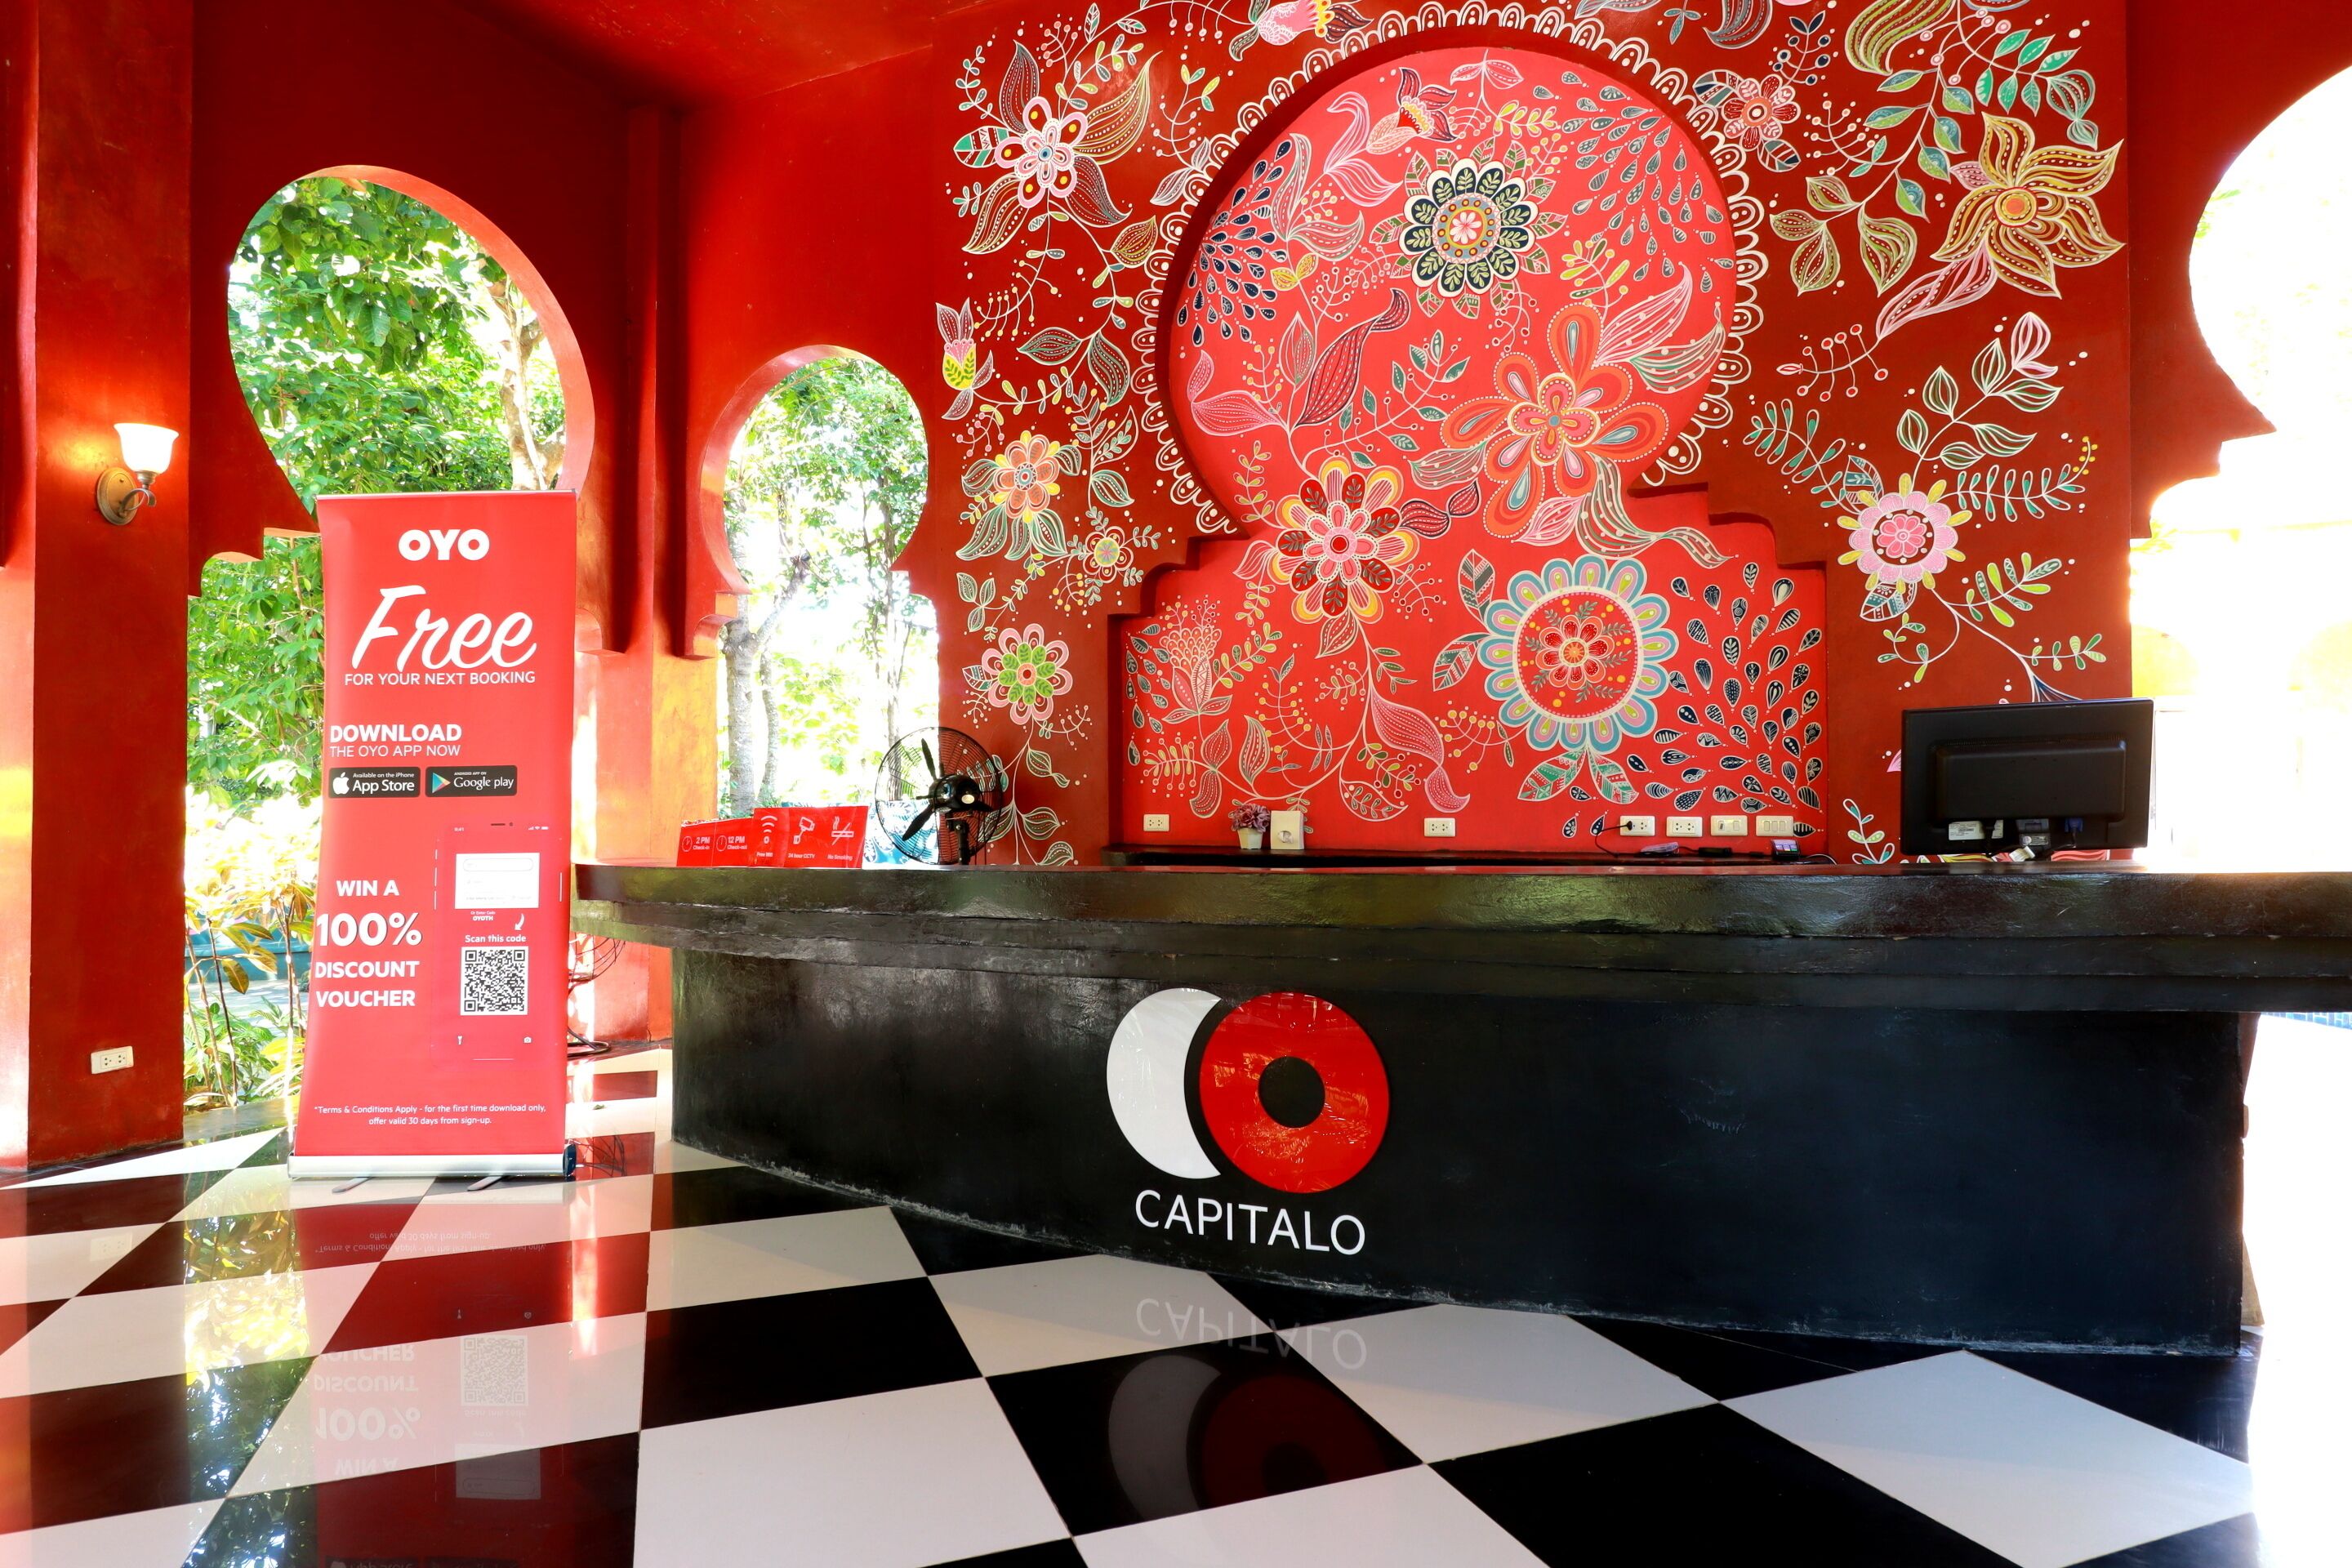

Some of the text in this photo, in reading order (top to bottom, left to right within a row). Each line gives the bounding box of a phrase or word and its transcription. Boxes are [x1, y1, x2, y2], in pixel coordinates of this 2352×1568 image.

[399, 528, 490, 561] OYO
[351, 585, 537, 672] Free
[345, 670, 536, 686] FOR YOUR NEXT BOOKING
[329, 724, 462, 743] DOWNLOAD
[330, 744, 461, 757] THE OYO APP NOW
[352, 779, 415, 795] App Store
[453, 777, 514, 791] Google play
[696, 836, 710, 844] 2 PM
[728, 835, 746, 844] 12 PM
[336, 880, 400, 898] WIN A
[316, 911, 423, 947] 100%
[465, 933, 527, 943] Scan this code
[314, 960, 420, 979] DISCOUNT
[315, 989, 416, 1008] VOUCHER
[344, 1106, 350, 1114] &
[352, 1105, 393, 1114] Conditions
[394, 1105, 417, 1114] Apply
[425, 1105, 435, 1113] for
[452, 1104, 468, 1112] first
[470, 1104, 488, 1112] time
[489, 1103, 527, 1112] download
[368, 1116, 492, 1125] offer valid 30 days from sign-up.
[1134, 1189, 1366, 1255] CAPITALO
